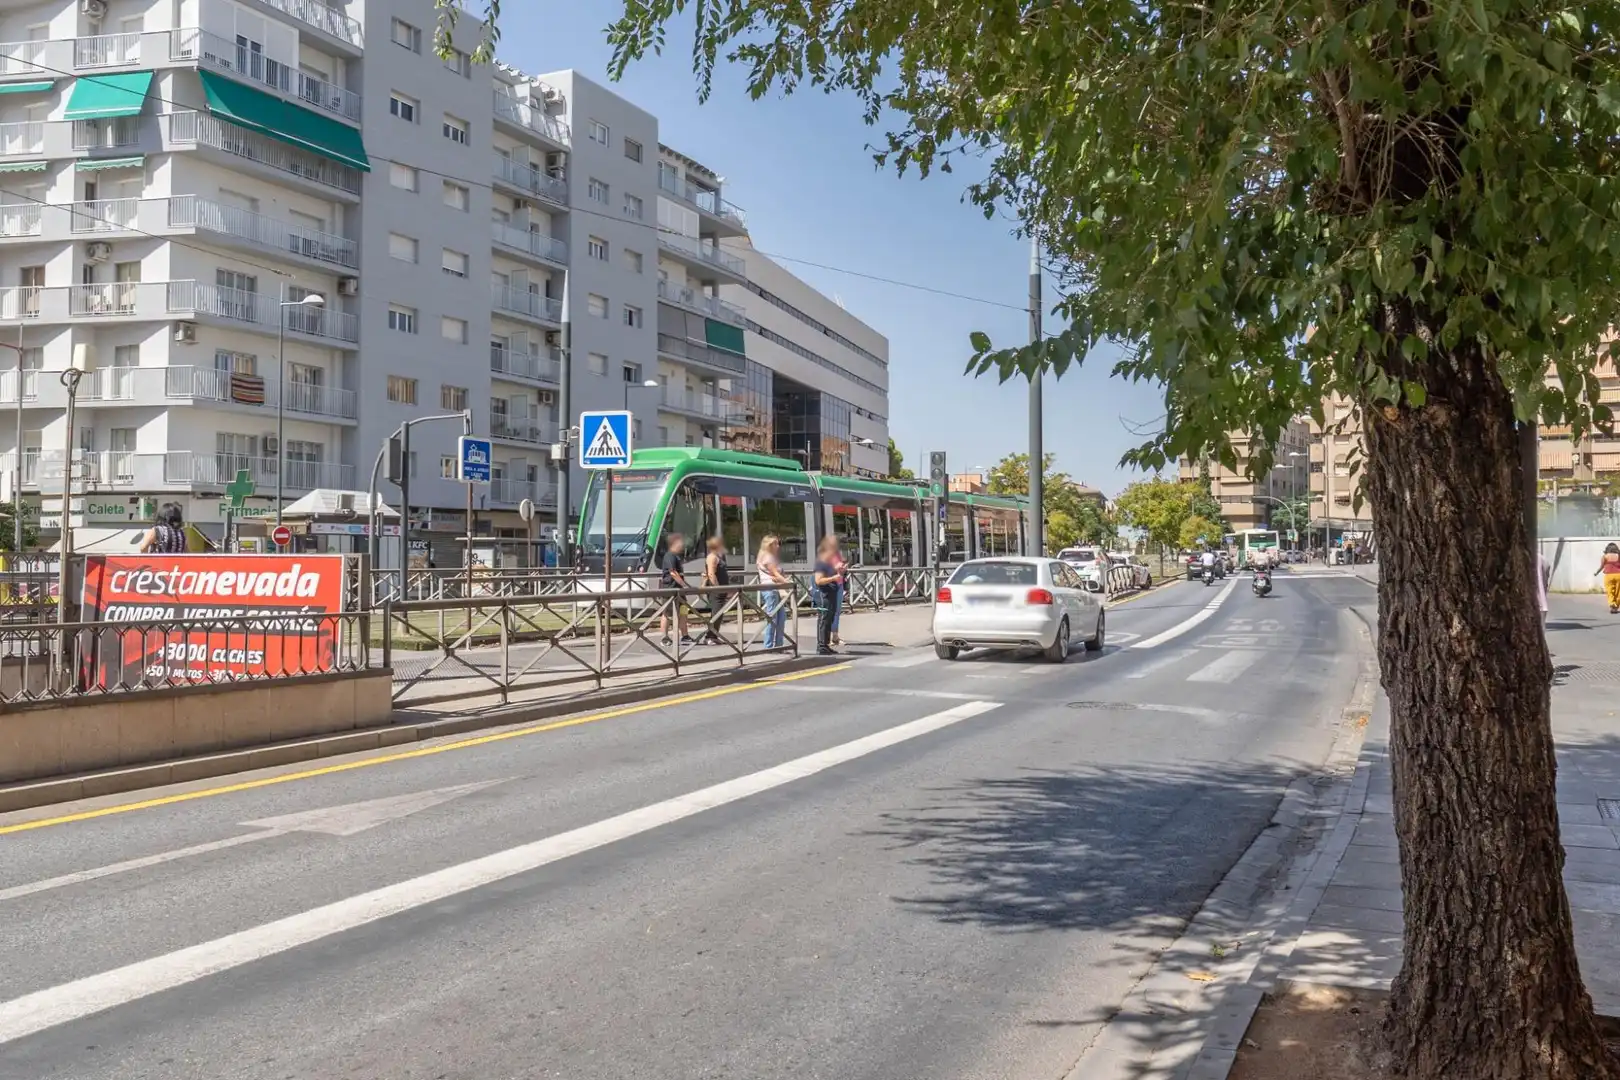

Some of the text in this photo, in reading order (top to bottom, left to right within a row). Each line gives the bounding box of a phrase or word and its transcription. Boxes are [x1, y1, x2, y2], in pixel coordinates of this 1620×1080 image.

[88, 503, 125, 515] Caleta
[412, 540, 428, 549] KFC
[110, 563, 320, 597] crestanevada
